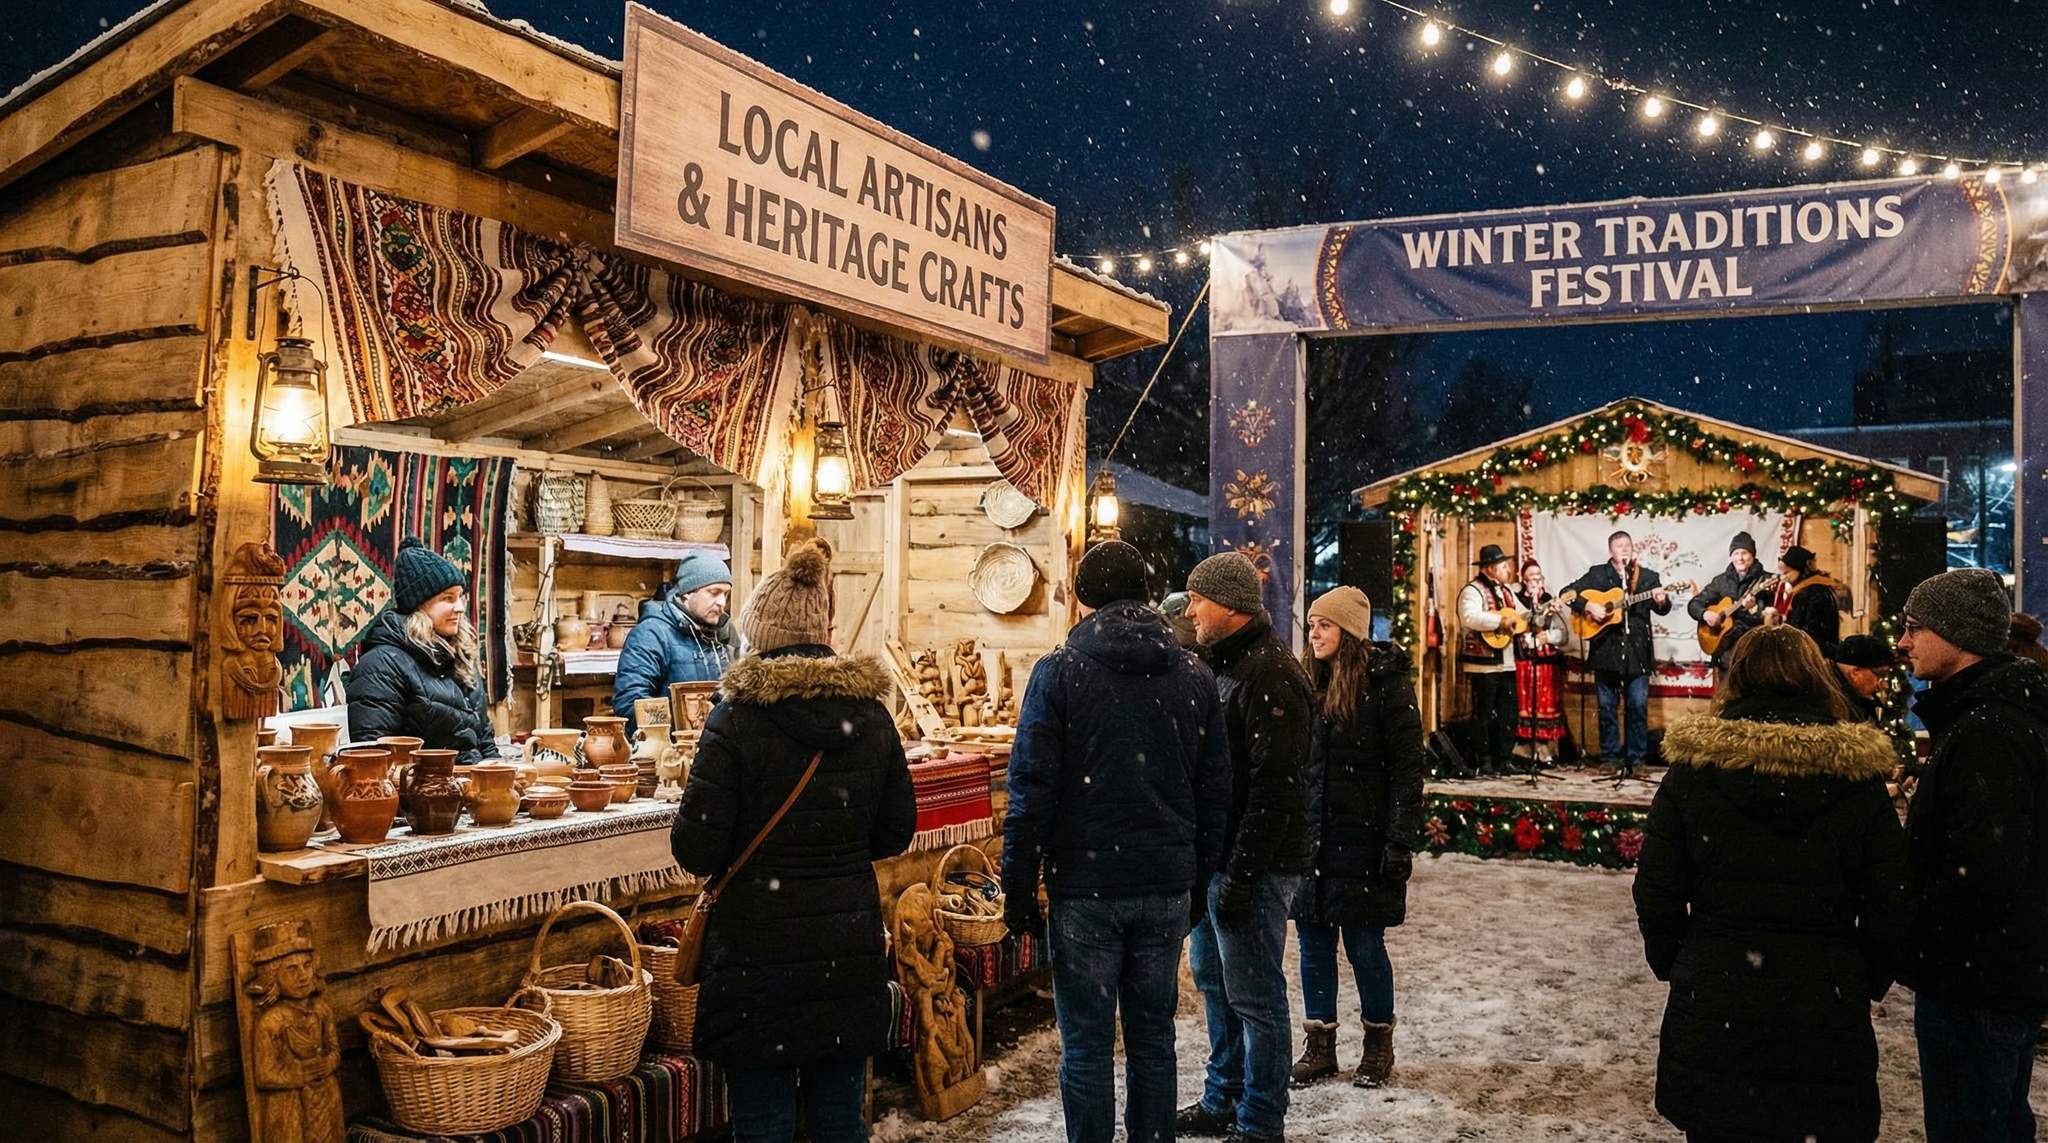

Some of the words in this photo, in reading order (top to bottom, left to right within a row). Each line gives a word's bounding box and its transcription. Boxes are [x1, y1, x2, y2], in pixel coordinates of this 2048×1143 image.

[718, 91, 848, 198] LOCAL
[857, 156, 1008, 261] ARTISANS
[1402, 220, 1583, 271] WINTER
[1596, 195, 1905, 257] TRADITIONS
[677, 162, 711, 230] &
[725, 177, 910, 294] HERITAGE
[919, 250, 1024, 330] CRAFTS
[1530, 256, 1753, 308] FESTIVAL
